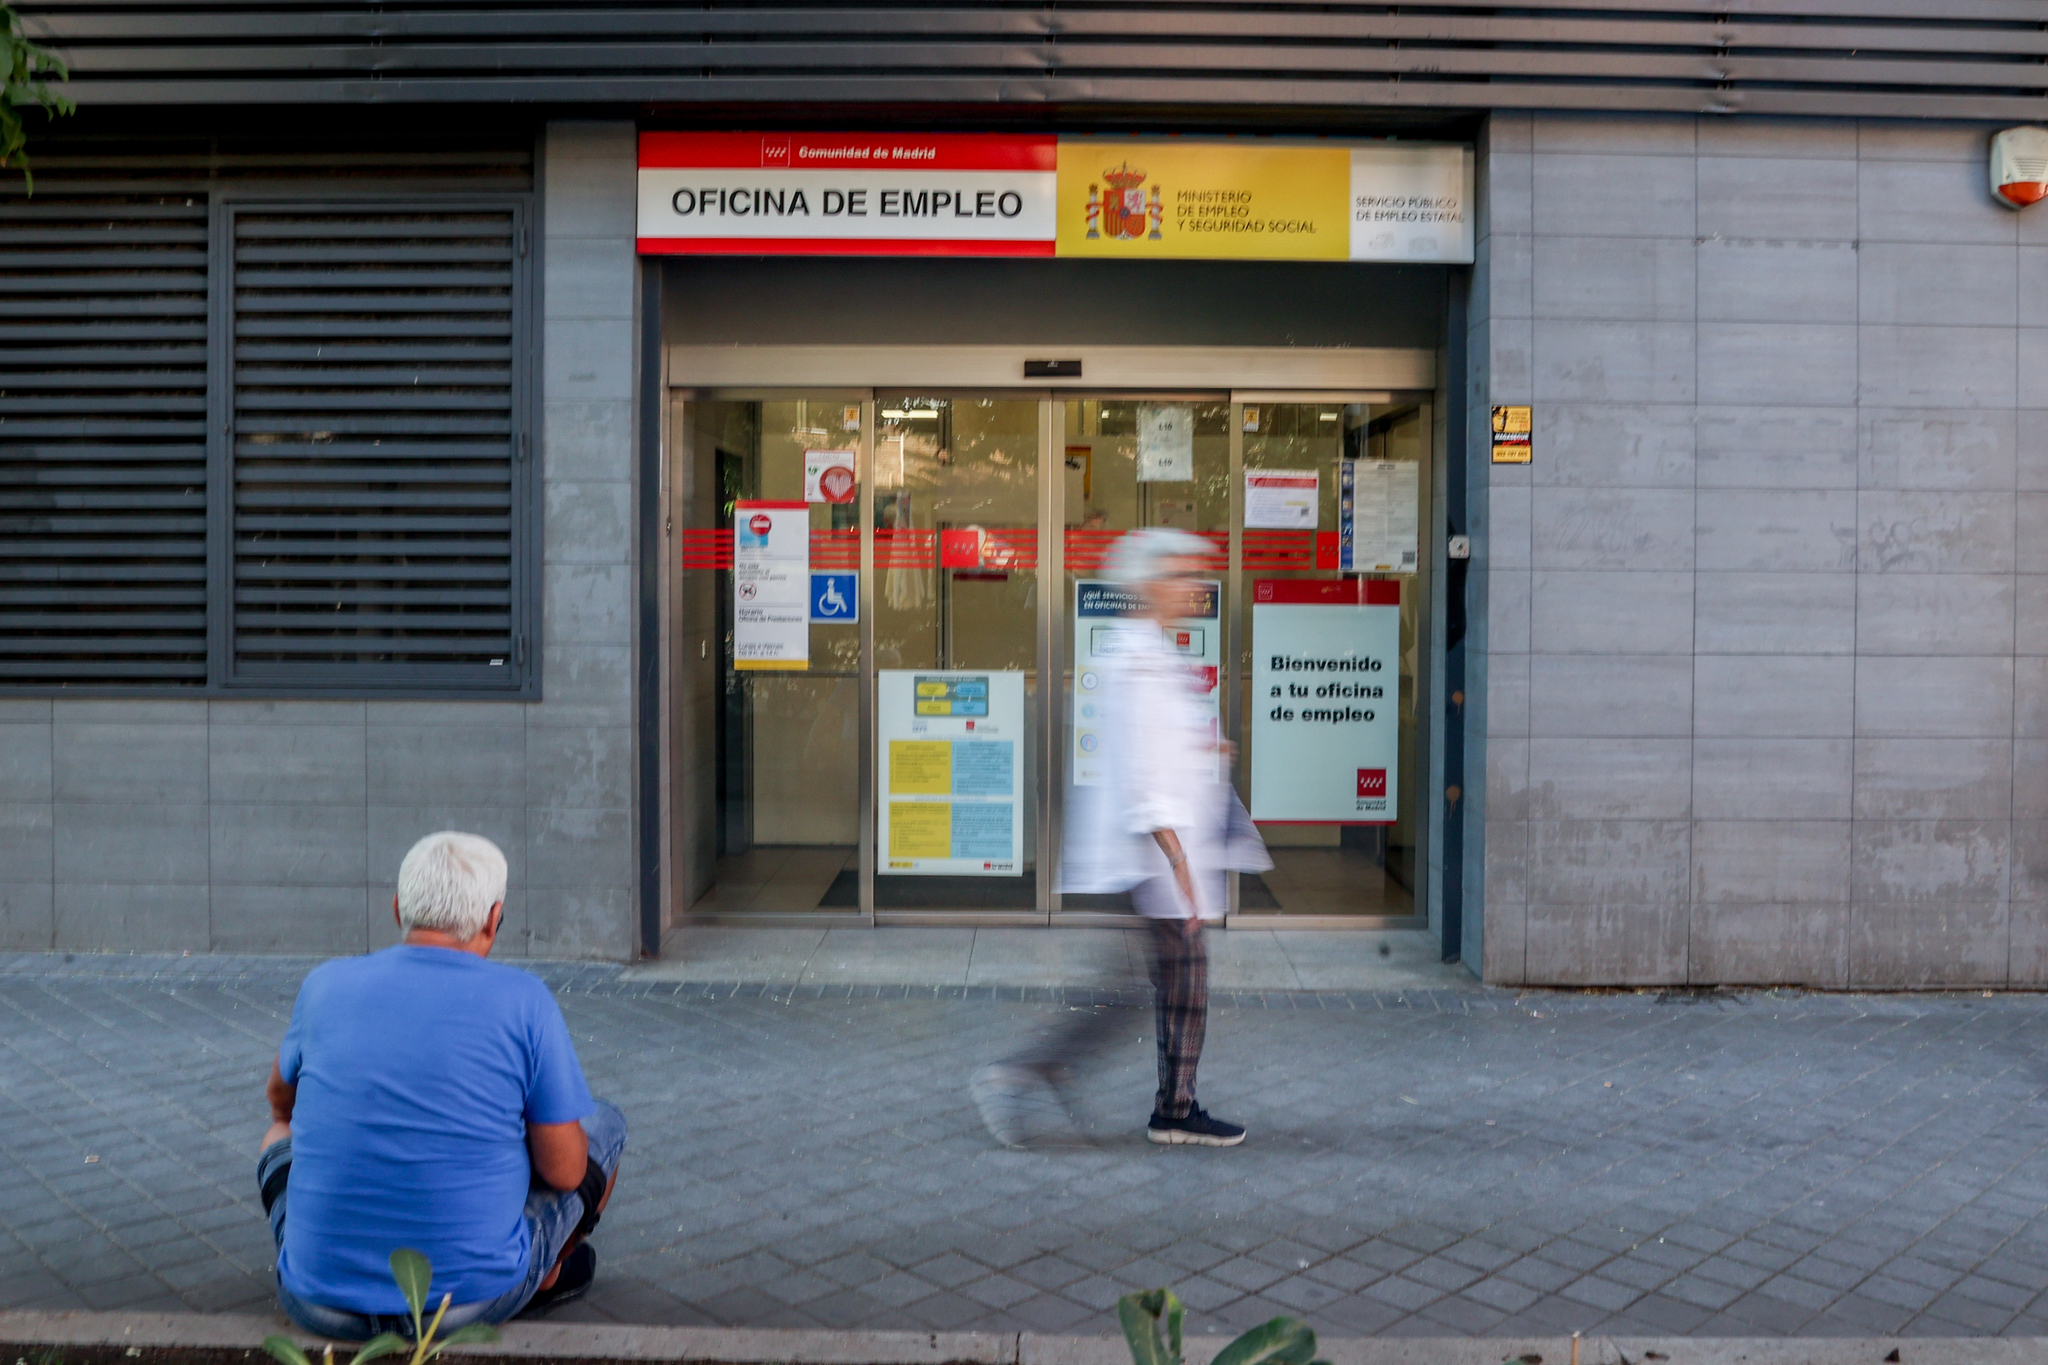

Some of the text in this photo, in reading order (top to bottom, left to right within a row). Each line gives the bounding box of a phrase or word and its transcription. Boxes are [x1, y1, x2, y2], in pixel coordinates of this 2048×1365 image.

[799, 146, 936, 160] Comunidad de Madrid
[671, 187, 1023, 219] OFICINA DE EMPLEO
[1177, 189, 1252, 203] MINISTERIO
[1356, 195, 1458, 210] SERVICIO PÚBLICO
[1177, 204, 1249, 218] DE EMPLEO
[1356, 209, 1464, 224] DE EMPLEO ESTATAL
[1177, 218, 1317, 234] Y SEGURIDAD SOCIAL
[1102, 591, 1138, 600] SERVICIOS
[1083, 601, 1094, 610] EN
[1094, 601, 1127, 610] OFICINAS
[1271, 655, 1382, 672] Bienvenido
[1270, 682, 1383, 699] a tu oficina
[1270, 705, 1375, 724] de empleo
